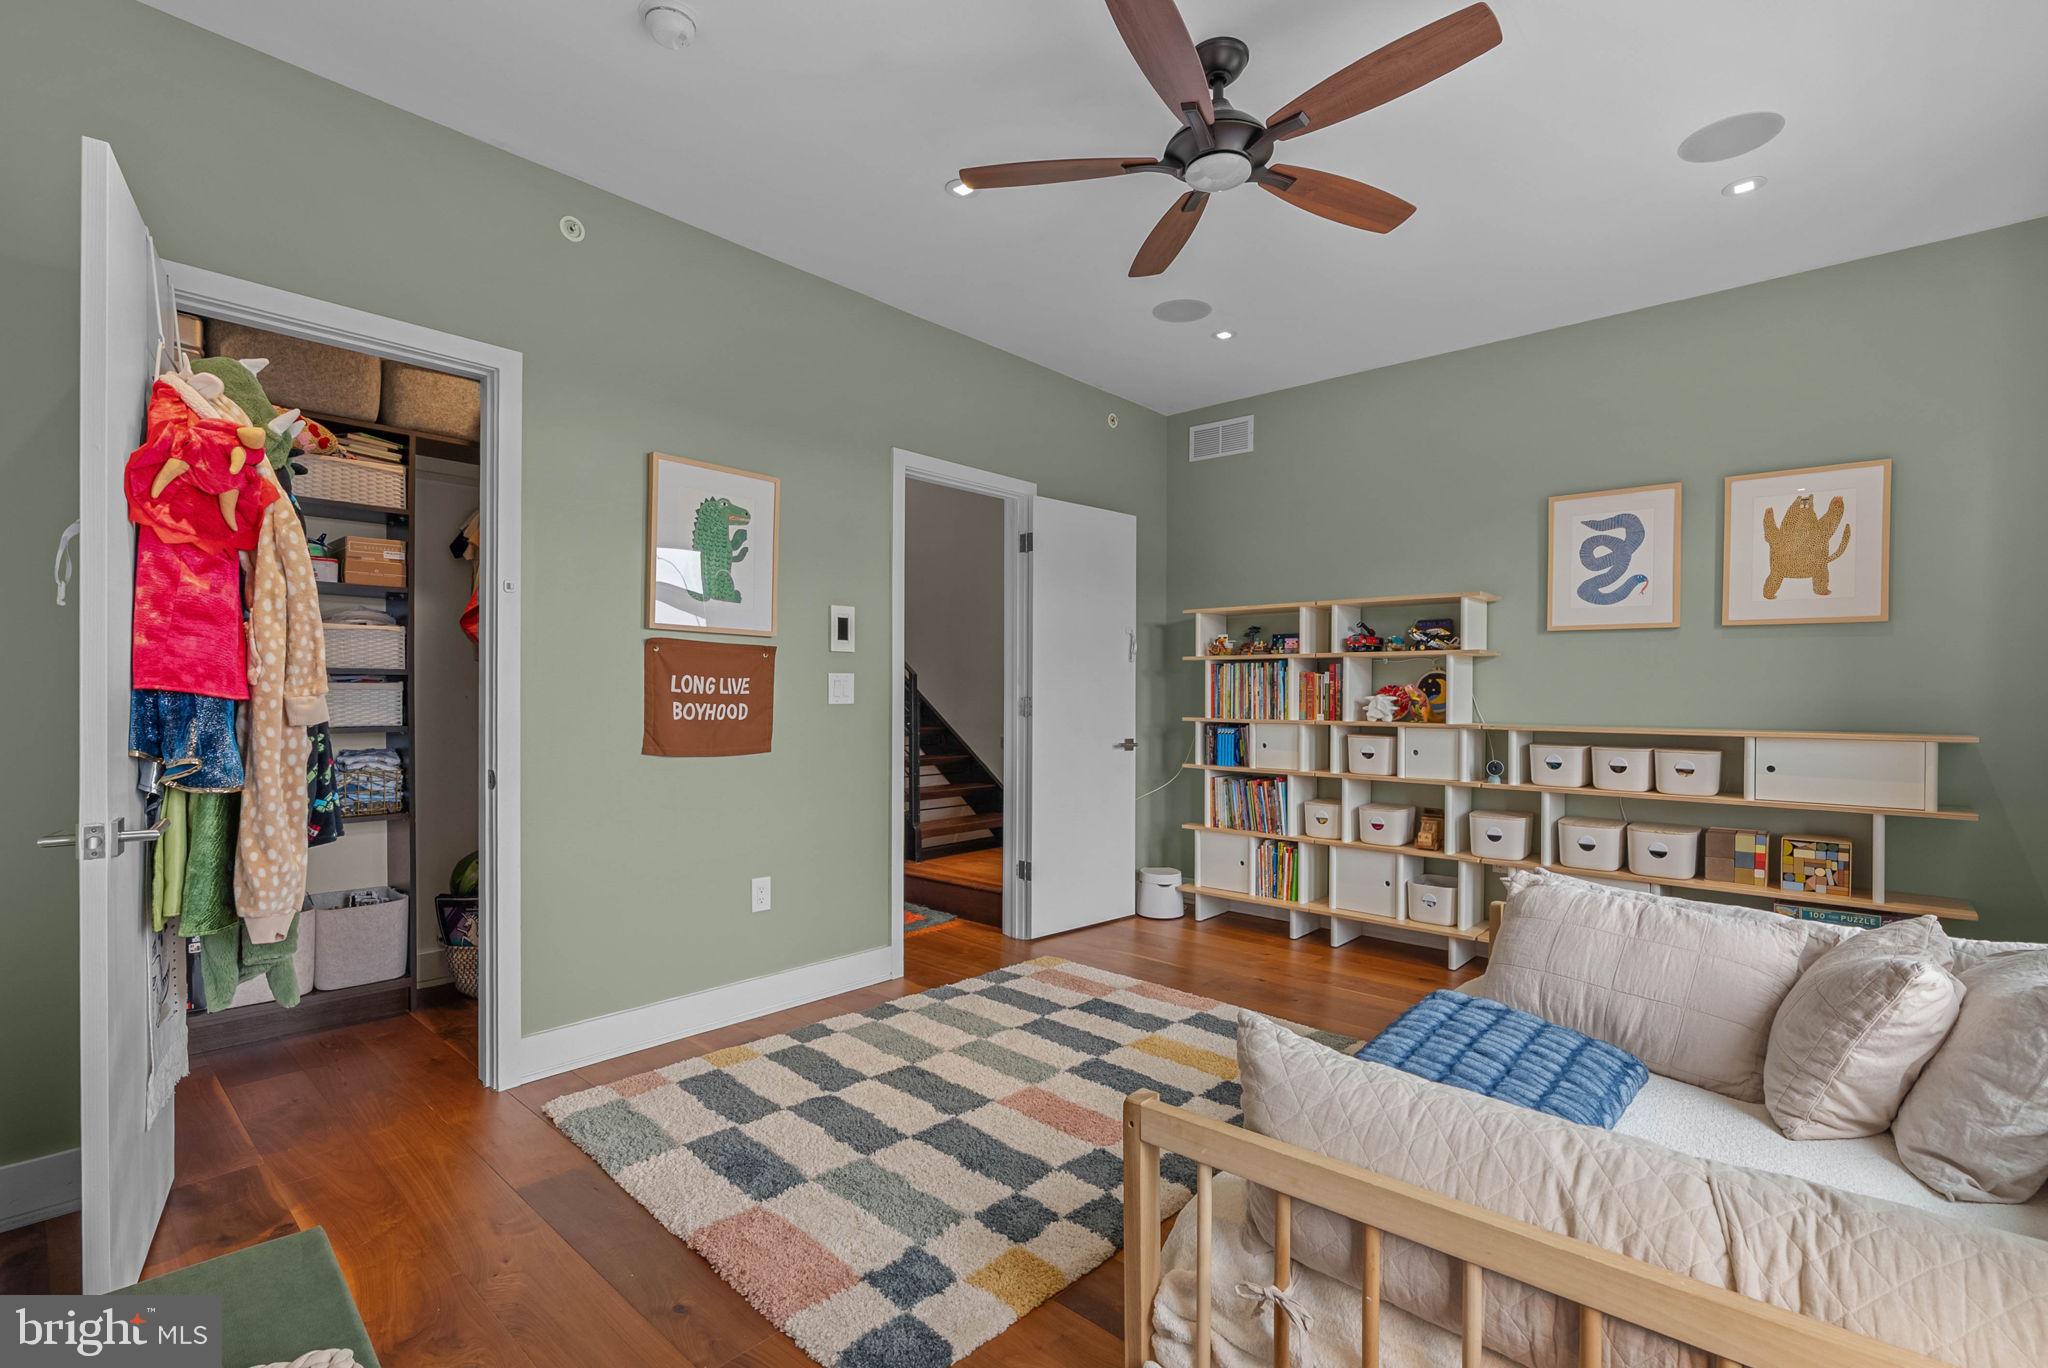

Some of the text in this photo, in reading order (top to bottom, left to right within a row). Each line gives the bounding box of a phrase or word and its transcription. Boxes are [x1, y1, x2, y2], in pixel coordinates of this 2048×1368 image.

[671, 674, 750, 695] LONG LIVE
[672, 701, 749, 721] BOYHOOD
[1809, 911, 1826, 920] 100
[1840, 915, 1876, 926] PUZZLE
